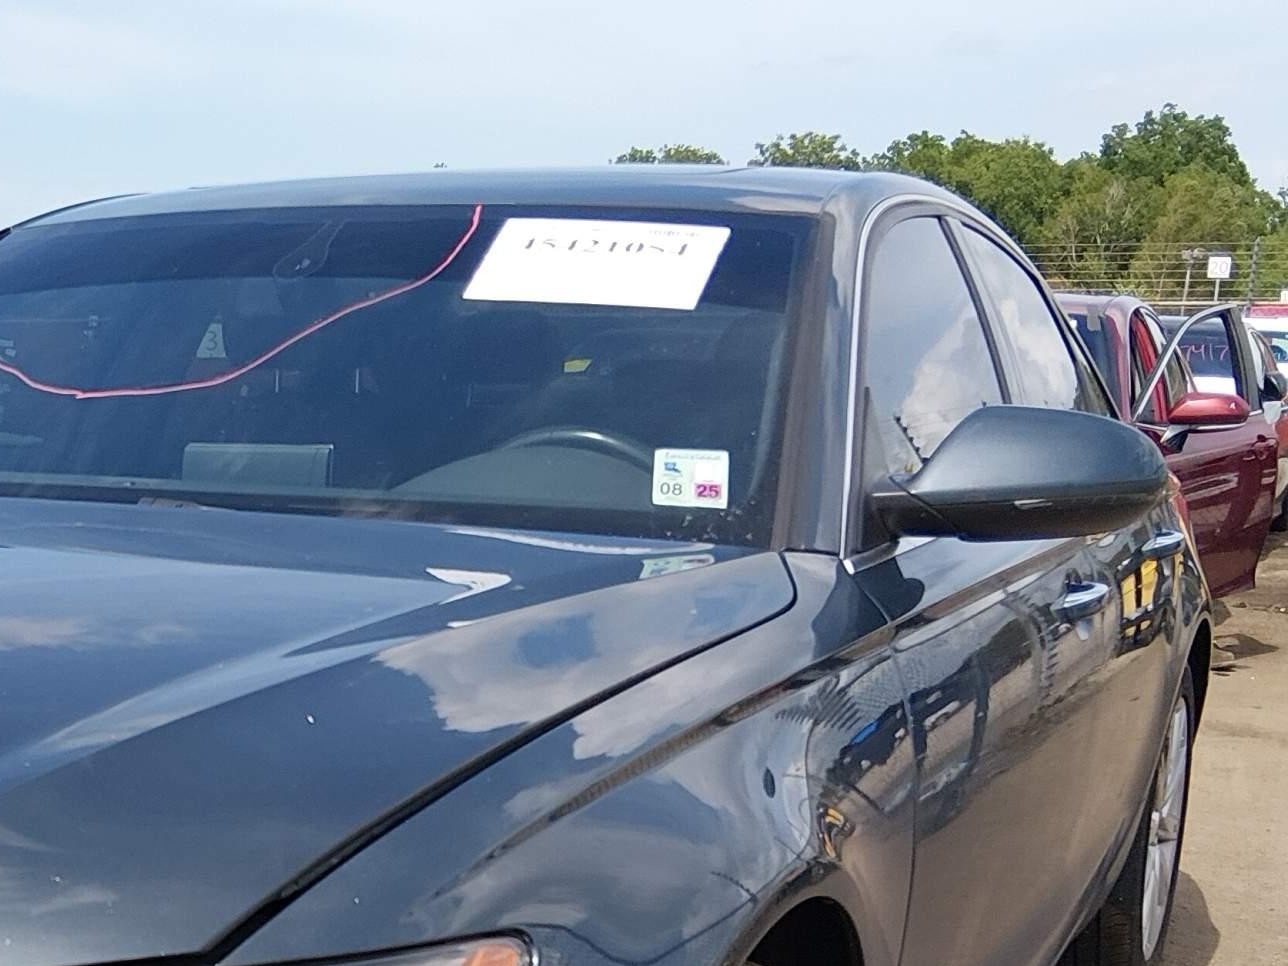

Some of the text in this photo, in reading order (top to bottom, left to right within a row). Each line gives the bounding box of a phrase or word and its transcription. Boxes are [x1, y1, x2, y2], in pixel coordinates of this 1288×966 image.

[206, 330, 218, 351] 3
[660, 482, 720, 498] 08 25
